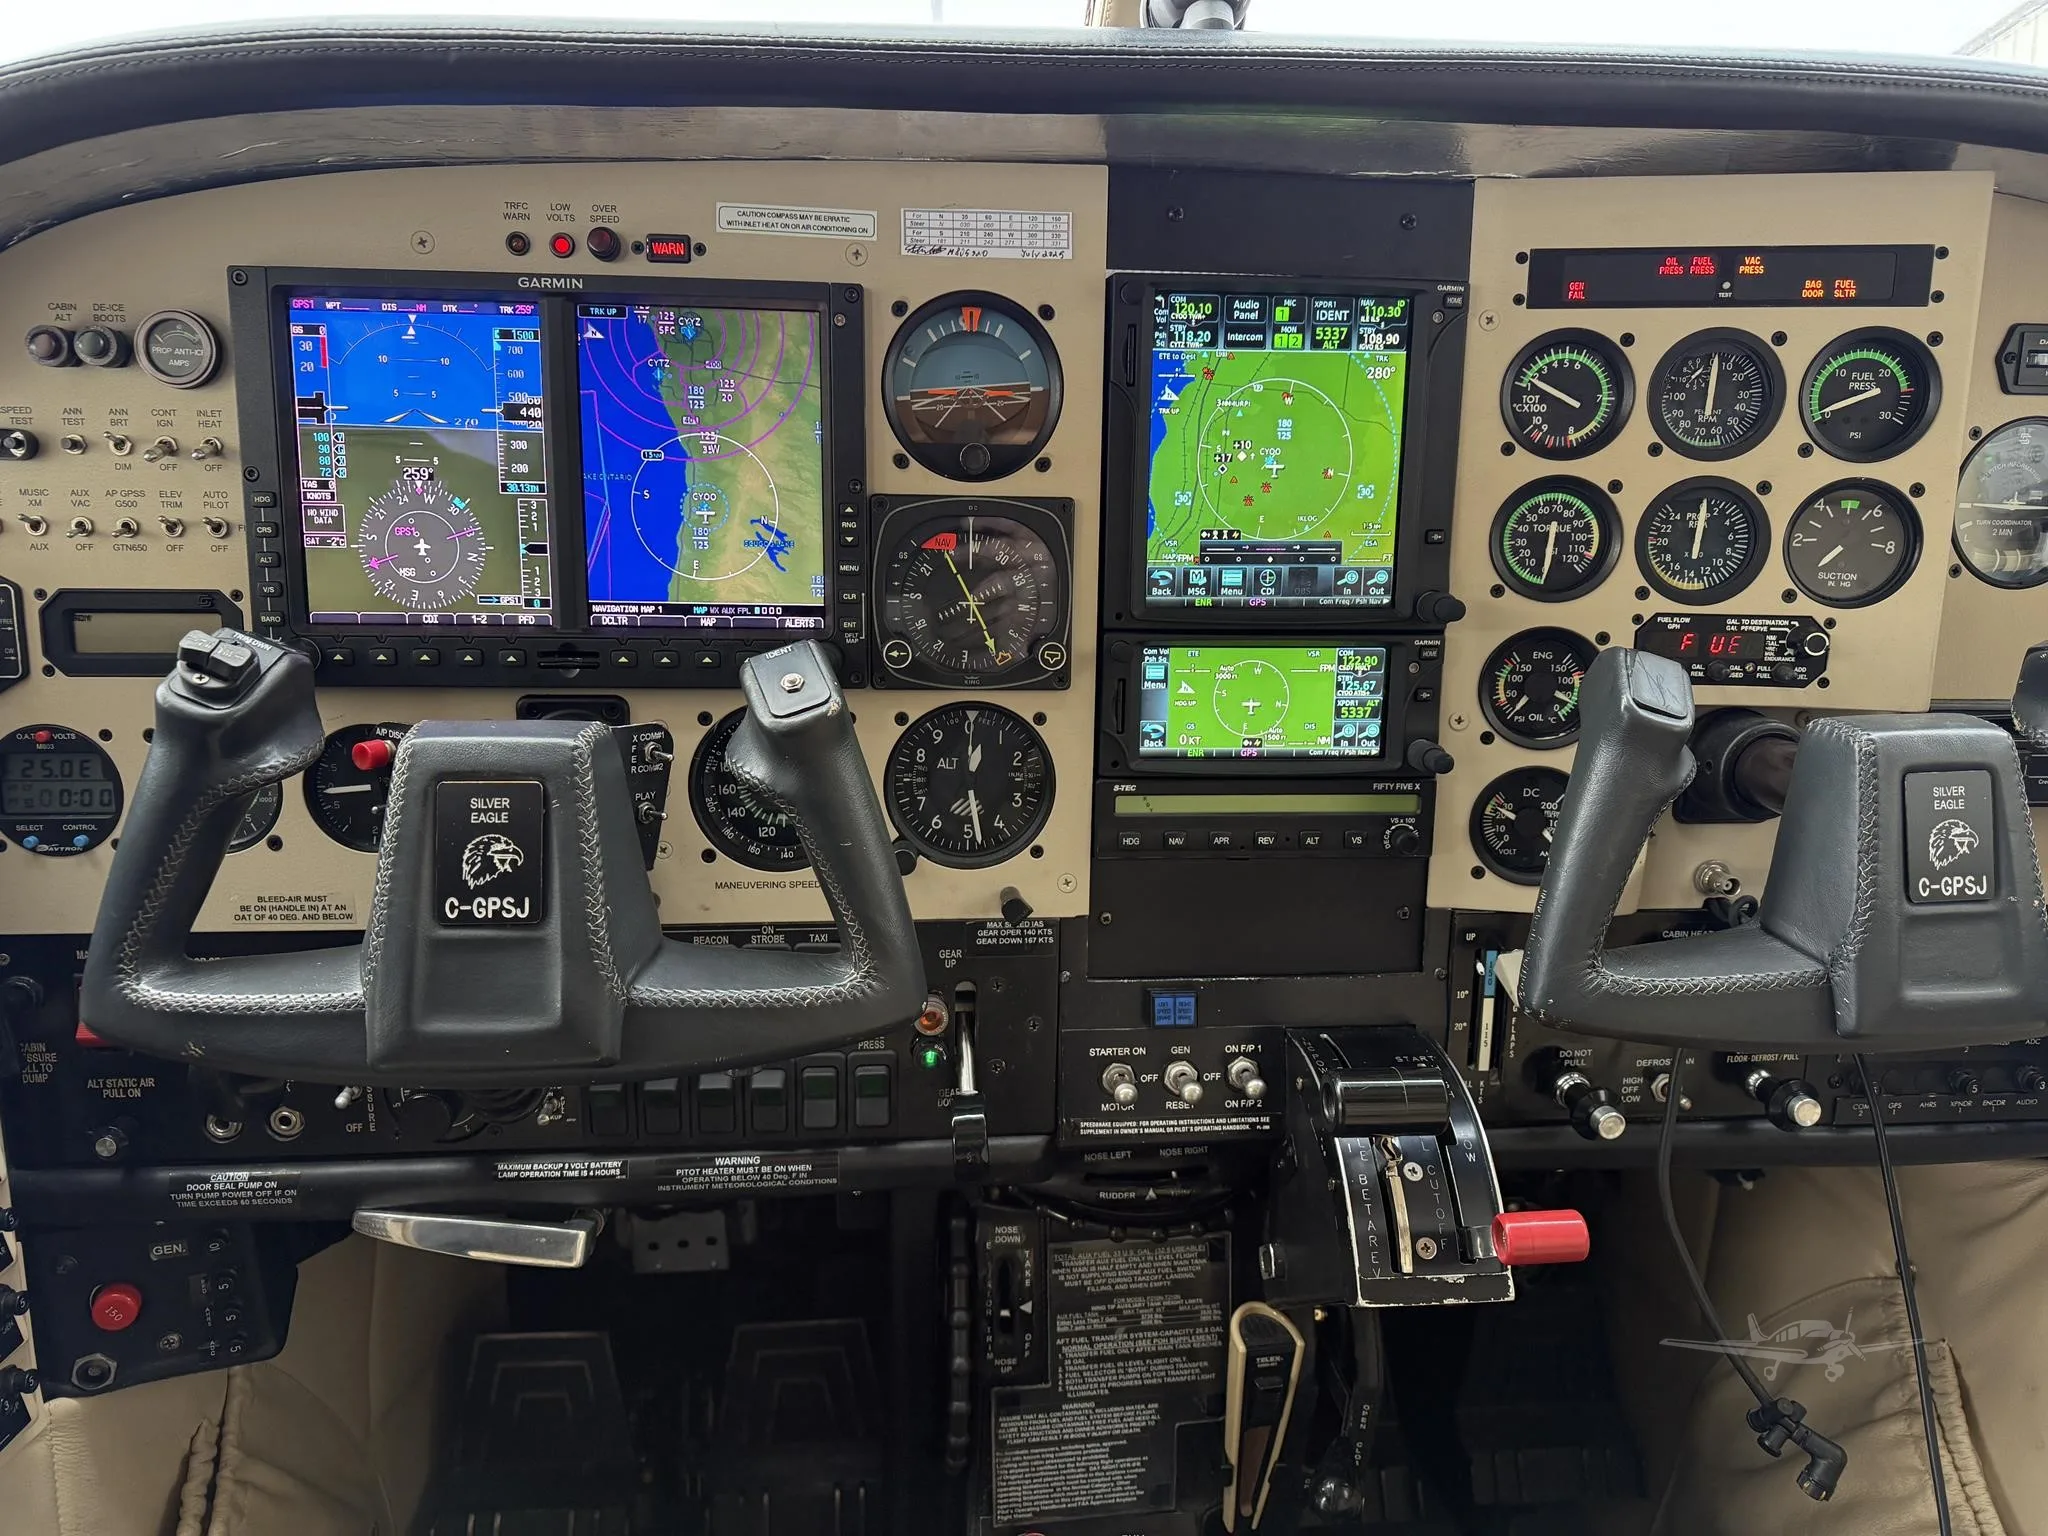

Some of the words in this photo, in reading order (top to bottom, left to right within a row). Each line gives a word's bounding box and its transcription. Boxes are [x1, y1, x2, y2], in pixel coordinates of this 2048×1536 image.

[505, 202, 528, 210] TRFC
[550, 203, 570, 211] LOW
[592, 205, 617, 213] OVER
[504, 212, 530, 221] WARN
[546, 214, 575, 222] VOLTS
[590, 215, 619, 223] SPEED
[737, 210, 766, 218] CAUTION
[767, 212, 798, 220] COMPASS
[823, 215, 850, 223] ERRATIC
[762, 221, 779, 229] HEAT
[801, 223, 812, 231] AIR
[812, 224, 857, 233] CONDITIONING
[652, 242, 684, 255] WARN
[1665, 257, 1678, 265] OIL
[1692, 256, 1712, 265] FUEL
[1745, 256, 1761, 265] VAC
[1659, 266, 1684, 275] PRESS
[1690, 265, 1715, 274] PRESS
[1739, 265, 1764, 274] PRESS
[518, 277, 583, 289] GARMIN
[1569, 282, 1585, 290] GEN
[1805, 280, 1822, 289] BAG
[1835, 280, 1856, 289] FUEL
[1437, 284, 1464, 292] GARMIN
[1568, 291, 1585, 299] FAIL
[1802, 289, 1824, 298] DOOR
[1834, 289, 1856, 298] SLTR
[48, 303, 77, 312] CABIN
[93, 304, 125, 312] DE-ICE
[293, 300, 314, 309] GPS1
[1233, 300, 1260, 310] Audio
[590, 307, 603, 316] TRK
[605, 308, 617, 316] UP
[1233, 310, 1259, 320] Panel
[1316, 310, 1349, 321] IDENT
[93, 314, 126, 322] BOOTS
[1227, 332, 1263, 342] Intercom
[1316, 327, 1347, 340] 5337
[1366, 367, 1397, 380] 280°
[1851, 372, 1875, 382] FUEL
[1848, 381, 1877, 391] PRESS
[63, 408, 82, 416] ANN
[108, 408, 128, 416] ANN
[151, 409, 176, 417] CONT
[196, 410, 222, 418] INLET
[62, 418, 85, 426] TEST
[110, 419, 128, 427] BRT
[198, 420, 222, 428] HEAT
[114, 463, 132, 471] DIM
[159, 463, 177, 471] OFF
[204, 464, 222, 472] OFF
[159, 490, 182, 498] ELEV
[203, 491, 228, 499] AUTO
[203, 501, 229, 509] PILOT
[935, 538, 951, 548] NAV
[113, 544, 147, 552] GTN650
[166, 544, 184, 552] OFF
[210, 544, 229, 552] OFF
[1818, 572, 1857, 580] SUCTION
[1152, 586, 1171, 596] Back
[1187, 587, 1206, 596] MSG
[1220, 587, 1243, 596] Menu
[1370, 587, 1384, 596] Out
[592, 605, 639, 613] NAVIGATION
[641, 605, 656, 613] MAP
[518, 615, 535, 624] PFD
[602, 617, 628, 625] DCLTR
[785, 619, 815, 628] ALERTS
[765, 645, 793, 660] IDENT
[1144, 680, 1166, 690] Menu
[1341, 706, 1371, 718] 5337
[1529, 713, 1544, 722] OIL
[1144, 739, 1164, 748] Back
[937, 758, 958, 769] ALT
[1113, 784, 1137, 792] S-TEC
[1373, 783, 1391, 791] FIFTY
[1393, 783, 1412, 791] FIVE
[1933, 786, 1965, 797] SILVER
[635, 792, 656, 800] PLAY
[470, 798, 510, 809] SILVER
[1934, 799, 1965, 810] EAGLE
[471, 813, 509, 823] EAGLE
[1122, 837, 1140, 845] HDG
[1168, 837, 1184, 845] NAV
[1213, 837, 1230, 845] APR
[1258, 836, 1274, 845] REV
[1306, 837, 1319, 845] ALT
[1351, 836, 1362, 845] VS
[715, 880, 786, 890] MANEUVERING
[1919, 876, 1987, 897] C-GPSJ
[257, 895, 304, 903] BLEED-AIR
[445, 897, 530, 918] C-GPSJ
[693, 935, 729, 945] BEACON
[751, 934, 785, 944] STROBE
[809, 934, 828, 943] TAXI
[976, 937, 997, 945] GEAR
[999, 937, 1020, 945] DOWN
[1466, 933, 1476, 941] UP
[939, 950, 962, 959] GEAR
[945, 960, 956, 968] UP
[1089, 1047, 1130, 1056] STARTER
[1133, 1047, 1146, 1055] ON
[1171, 1046, 1190, 1054] GEN
[1225, 1045, 1238, 1053] ON
[1240, 1045, 1255, 1053] F/P
[1559, 1050, 1573, 1058] DO
[1575, 1050, 1592, 1058] NOT
[1564, 1058, 1586, 1066] PULL
[1140, 1074, 1158, 1082] OFF
[1203, 1073, 1221, 1081] OFF
[1623, 1077, 1643, 1085] HIGH
[87, 1078, 104, 1088] ALT
[106, 1078, 138, 1088] STATIC
[139, 1078, 154, 1087] AIR
[103, 1088, 125, 1098] PULL
[127, 1088, 141, 1098] ON
[1622, 1086, 1639, 1094] OFF
[1622, 1095, 1640, 1103] LOW
[715, 1157, 760, 1165] WARNING
[210, 1173, 248, 1182] CAUTION
[153, 1244, 186, 1255] GEN.
